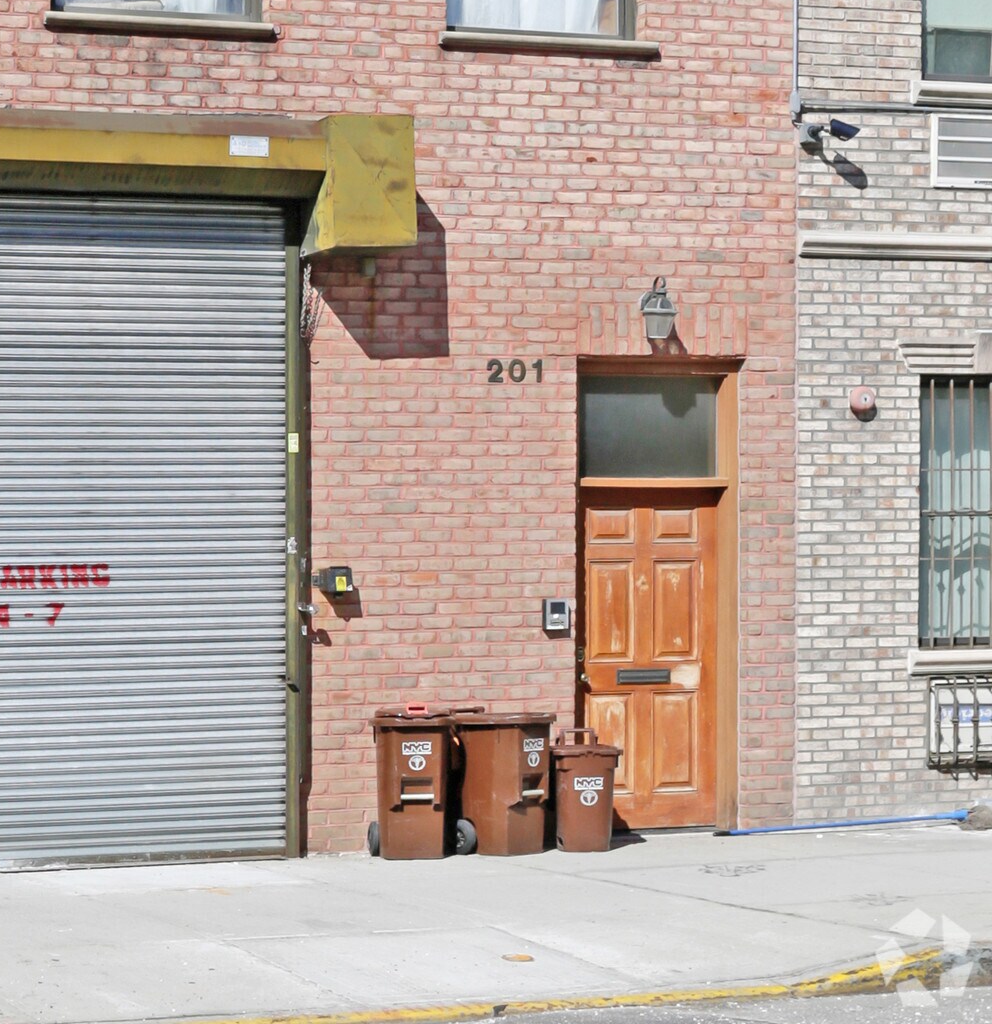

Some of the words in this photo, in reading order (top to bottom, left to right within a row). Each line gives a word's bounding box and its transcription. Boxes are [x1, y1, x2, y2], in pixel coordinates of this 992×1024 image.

[486, 358, 543, 383] 201
[402, 742, 432, 753] NYC
[523, 738, 544, 750] NYC
[574, 777, 604, 788] NYC
